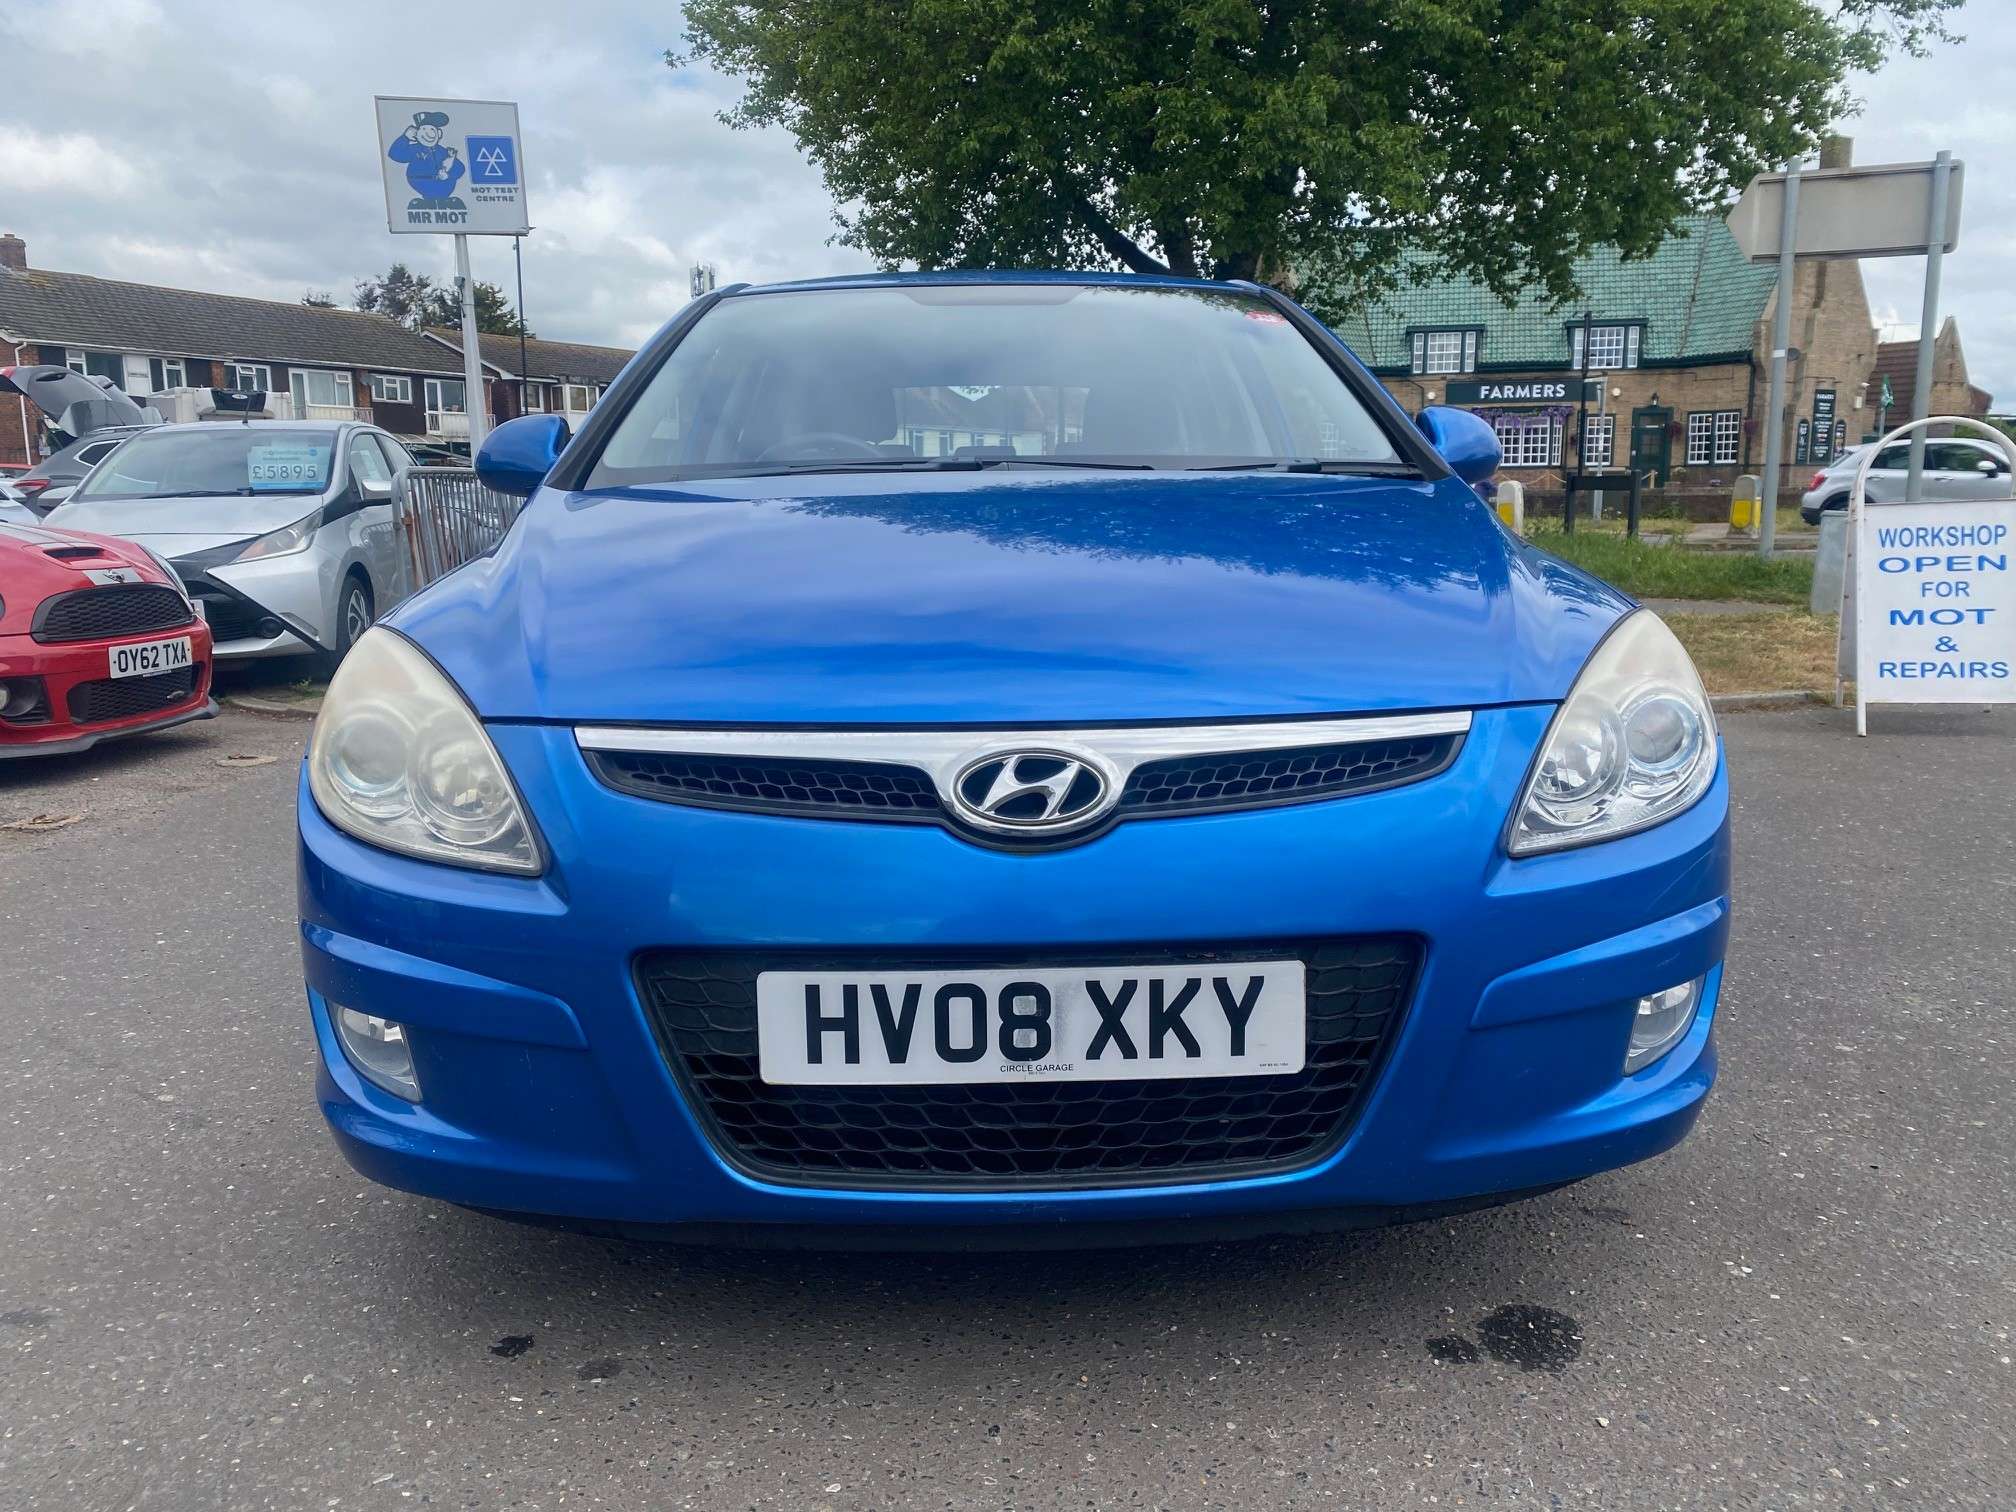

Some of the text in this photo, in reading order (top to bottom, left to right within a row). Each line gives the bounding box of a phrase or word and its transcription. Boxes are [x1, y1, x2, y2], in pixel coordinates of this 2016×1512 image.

[407, 211, 468, 224] MR MOT
[1480, 384, 1566, 399] FARMERS
[252, 465, 316, 480] £5895
[1878, 524, 2007, 549] WORKSHOP
[1878, 554, 2007, 574] OPEN
[1921, 581, 1970, 598] FOR
[1889, 608, 1996, 626] MOT
[1935, 636, 1960, 652] &
[117, 641, 188, 673] OY62 TXA
[1879, 661, 2010, 679] REPAIRS
[804, 975, 1265, 1064] HV08 XKY
[1035, 1064, 1074, 1072] GARAGE
